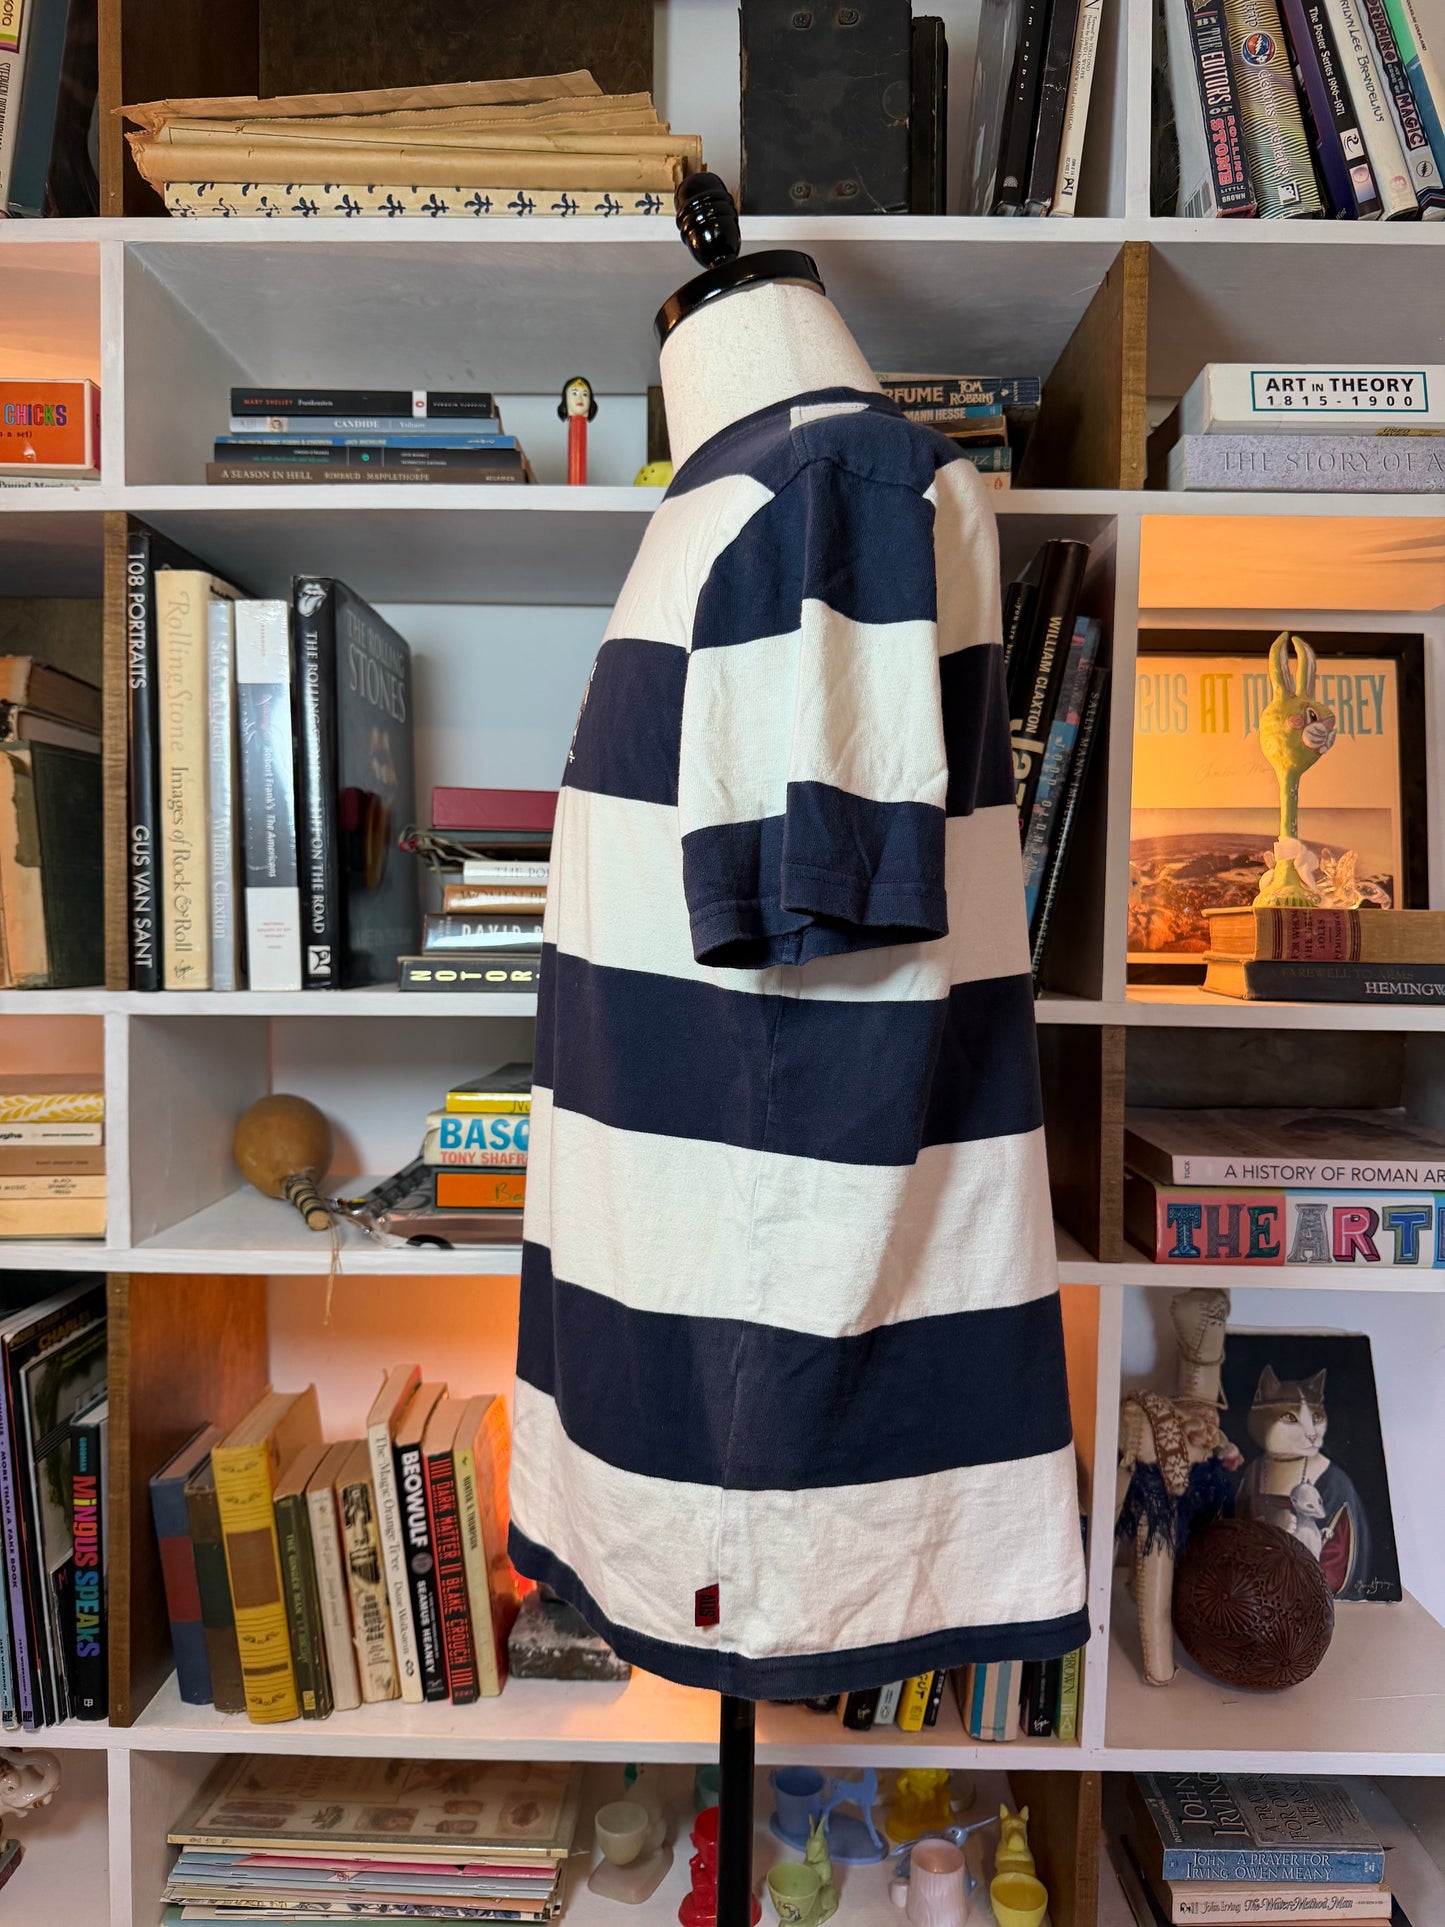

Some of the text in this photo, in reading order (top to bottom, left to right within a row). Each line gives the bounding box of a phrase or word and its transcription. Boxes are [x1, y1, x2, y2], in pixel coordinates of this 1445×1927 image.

[1197, 28, 1222, 51] THE
[1308, 6, 1319, 24] The
[1314, 25, 1326, 50] Poster
[1320, 50, 1334, 76] Series
[1201, 51, 1231, 106] EDITORS
[1258, 69, 1278, 118] dennis
[1209, 105, 1233, 115] OF
[1397, 94, 1425, 147] MAGIC
[1210, 117, 1233, 187] STONE
[1227, 115, 1244, 183] ROLLING
[1267, 120, 1291, 178] mcnally
[1221, 193, 1246, 203] BROWN
[950, 392, 995, 406] ROBBINS
[958, 380, 983, 393] TOM
[1265, 378, 1414, 392] ART IN THEORY
[4, 403, 67, 426] CHICKS
[334, 420, 380, 429] CANDIDE
[935, 407, 966, 420] HESSE
[222, 470, 312, 481] A SEASON IN HELL
[324, 473, 429, 482] RIMBAUD MAPPLETHORPE
[1222, 452, 1273, 472] THE
[1286, 451, 1372, 473] STORY
[1382, 452, 1418, 472] OF
[127, 552, 147, 689] 108 PORTRAITS
[346, 609, 367, 649] THE
[1009, 625, 1017, 640] are
[306, 631, 318, 659] THE
[350, 643, 406, 723] STONES
[1025, 616, 1062, 734] WILLIAM CLAXTON
[171, 689, 193, 752] Stone
[1082, 691, 1099, 732] SALLY
[1139, 673, 1188, 735] GUS
[1200, 673, 1233, 734] AT
[1071, 738, 1089, 778] MANN
[167, 767, 189, 826] Images
[171, 830, 191, 846] of
[266, 814, 275, 831] The
[266, 831, 277, 878] Americans
[312, 839, 324, 860] ON
[172, 848, 191, 892] Rock
[211, 817, 230, 939] William Claxton
[312, 864, 325, 891] THE
[132, 825, 154, 969] GUS VAN SANT
[313, 894, 326, 934] ROAD
[174, 918, 193, 952] Roll
[410, 970, 540, 982] NOTOR
[1281, 966, 1414, 980] FAREWELL TO ARMS
[1364, 981, 1445, 996] HEMINGW
[440, 1151, 528, 1165] TONY SHAFR
[1224, 1164, 1237, 1179] A
[1243, 1165, 1316, 1180] HISTORY
[1321, 1166, 1345, 1181] OF
[1352, 1168, 1418, 1183] ROMAN
[1167, 1203, 1433, 1265] THE ART
[375, 1434, 388, 1456] The
[379, 1460, 392, 1498] Magic
[1, 1450, 19, 1588] MORE THAN A FAKE BOOK
[401, 1451, 428, 1548] BEOWULF
[384, 1499, 397, 1541] Orange
[436, 1480, 461, 1560] DARK MATTER
[416, 1579, 431, 1627] SEAMUS
[445, 1577, 466, 1614] BLAKE
[422, 1628, 436, 1674] HEANEY
[450, 1618, 471, 1665] CROUCH
[1063, 1652, 1077, 1695] BROWN
[1168, 1775, 1219, 1827] JOHN
[1198, 1772, 1251, 1837] IRVING
[1185, 1852, 1230, 1879] JOHN IRVING
[1235, 1866, 1334, 1881] OWEN MEANY
[1237, 1854, 1332, 1867] A PRAYER FOR
